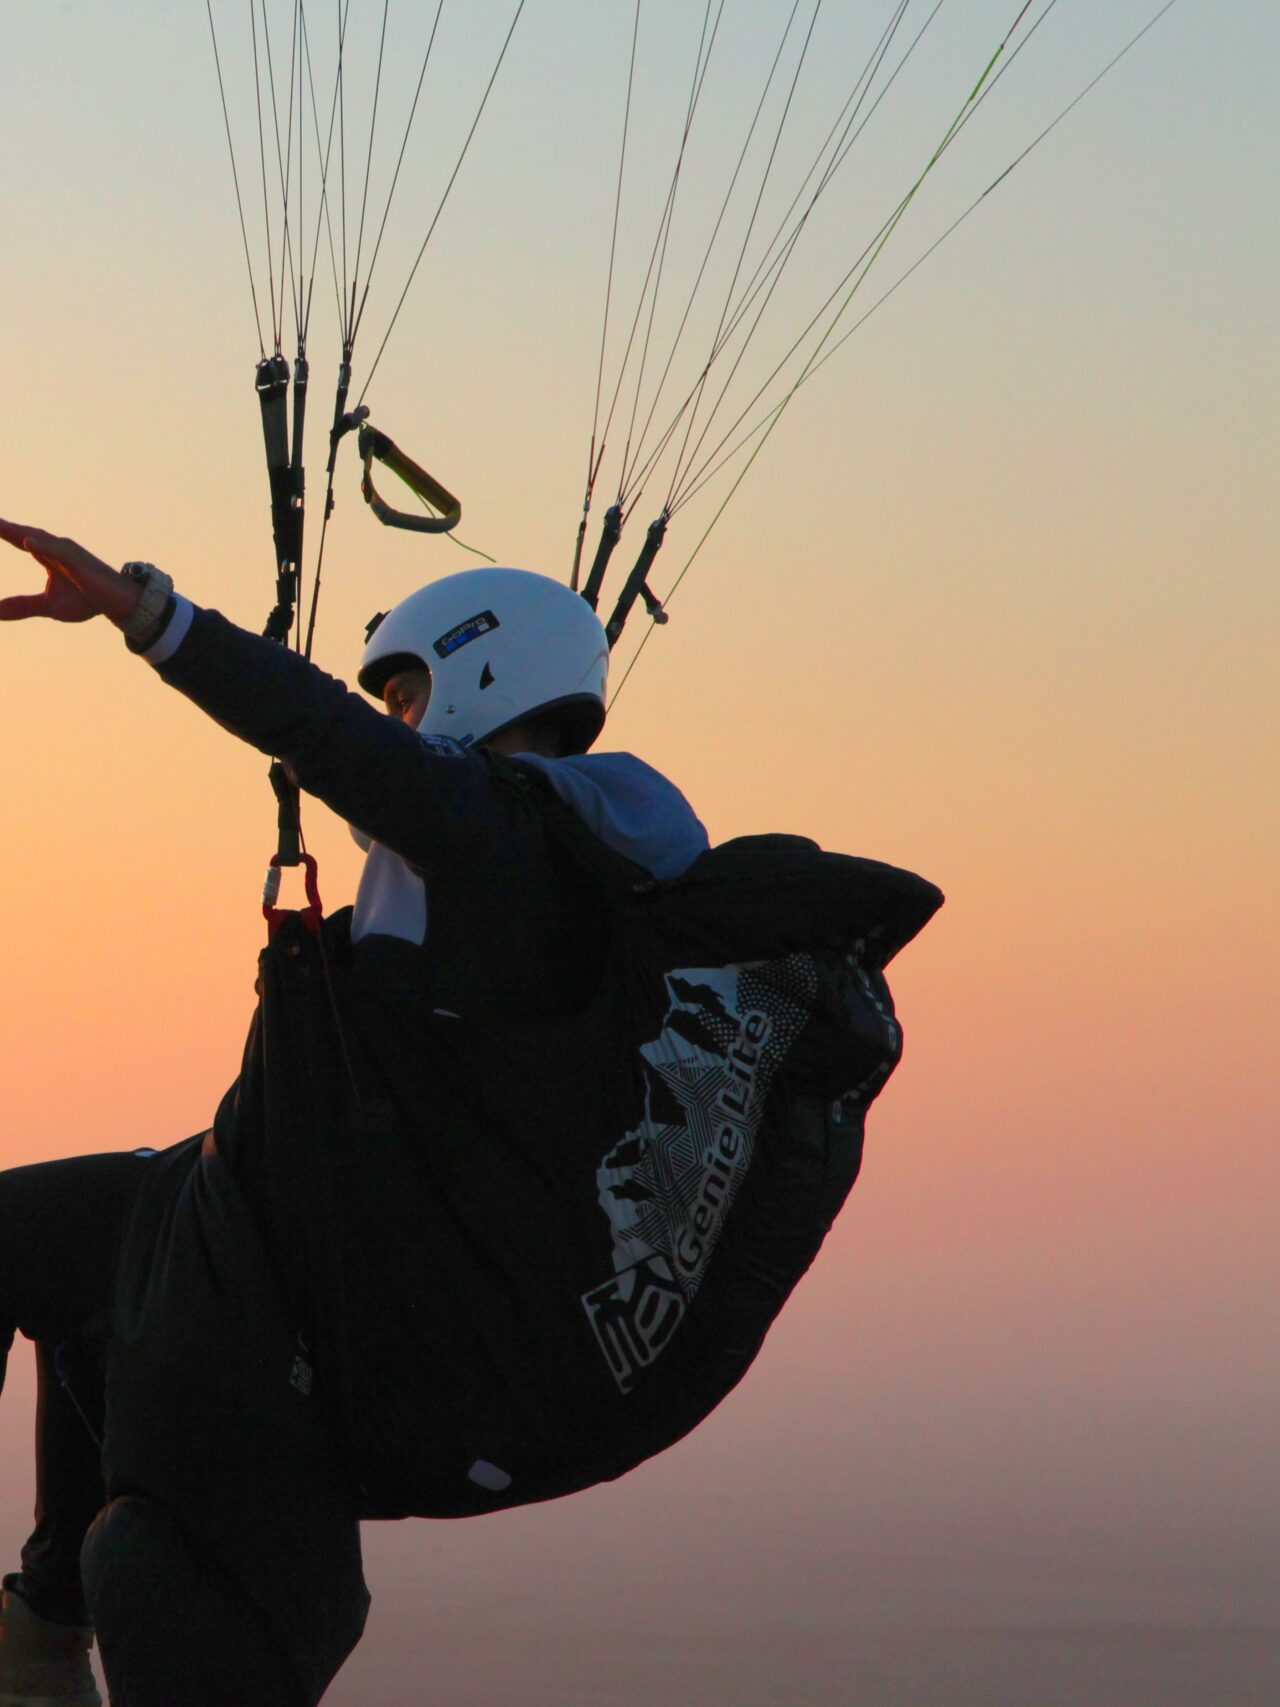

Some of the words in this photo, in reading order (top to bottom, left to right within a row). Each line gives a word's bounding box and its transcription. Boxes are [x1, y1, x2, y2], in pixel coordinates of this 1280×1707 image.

[441, 617, 486, 646] GoPro
[676, 1127, 740, 1273] Genie
[722, 1013, 769, 1116] Lite
